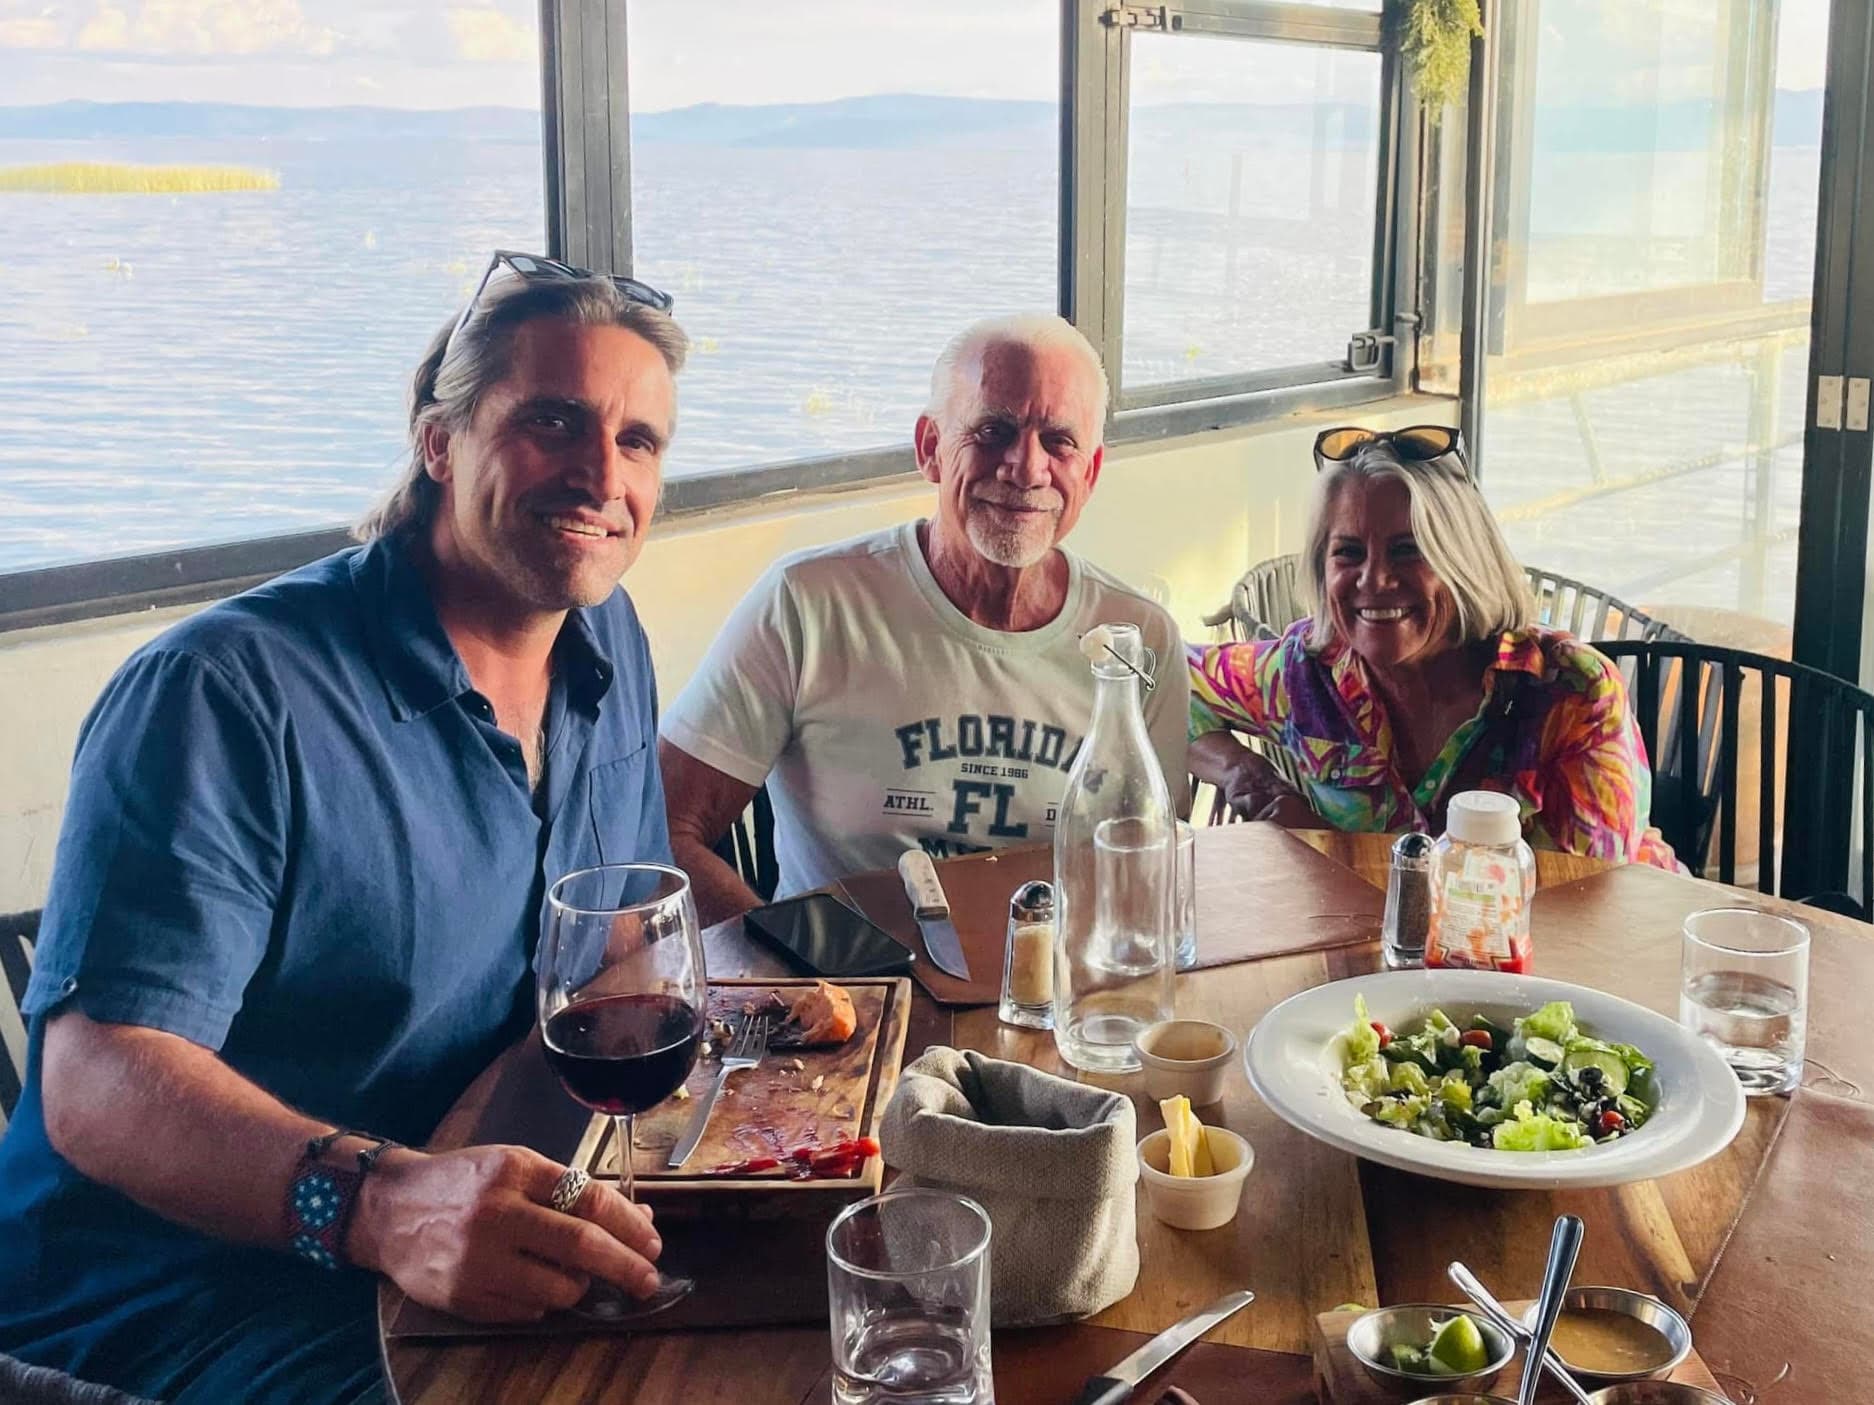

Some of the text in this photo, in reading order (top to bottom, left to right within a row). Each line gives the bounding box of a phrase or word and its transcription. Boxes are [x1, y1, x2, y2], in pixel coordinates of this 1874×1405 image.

[960, 762, 1029, 779] SINCE 1986
[883, 795, 935, 812] ATHL.
[946, 779, 1029, 838] FL
[1046, 808, 1057, 821] D
